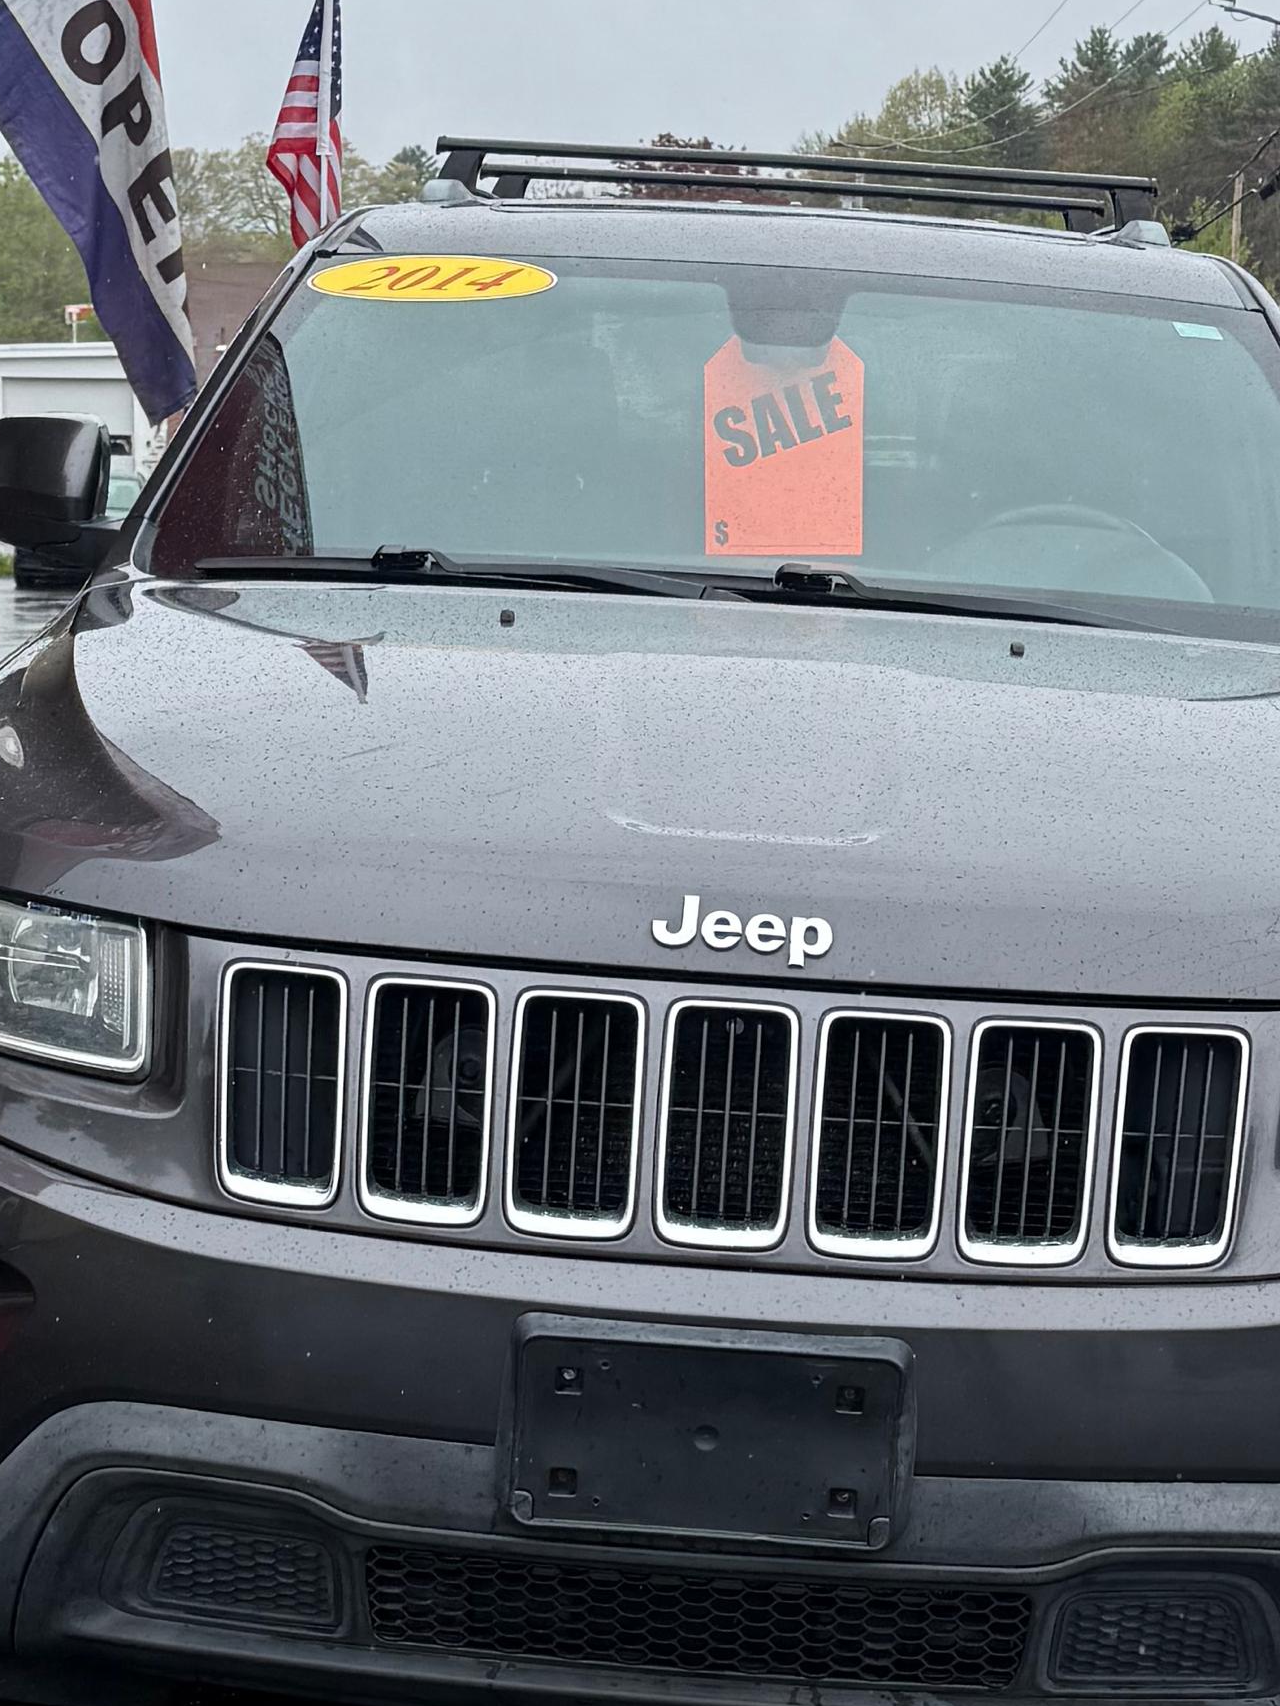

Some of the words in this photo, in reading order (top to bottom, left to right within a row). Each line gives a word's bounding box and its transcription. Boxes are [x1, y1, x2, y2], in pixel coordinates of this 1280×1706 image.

[61, 0, 186, 285] OPE
[343, 265, 525, 292] 2014
[713, 371, 853, 468] SALE
[714, 518, 729, 547] $
[651, 894, 834, 970] Jeep
